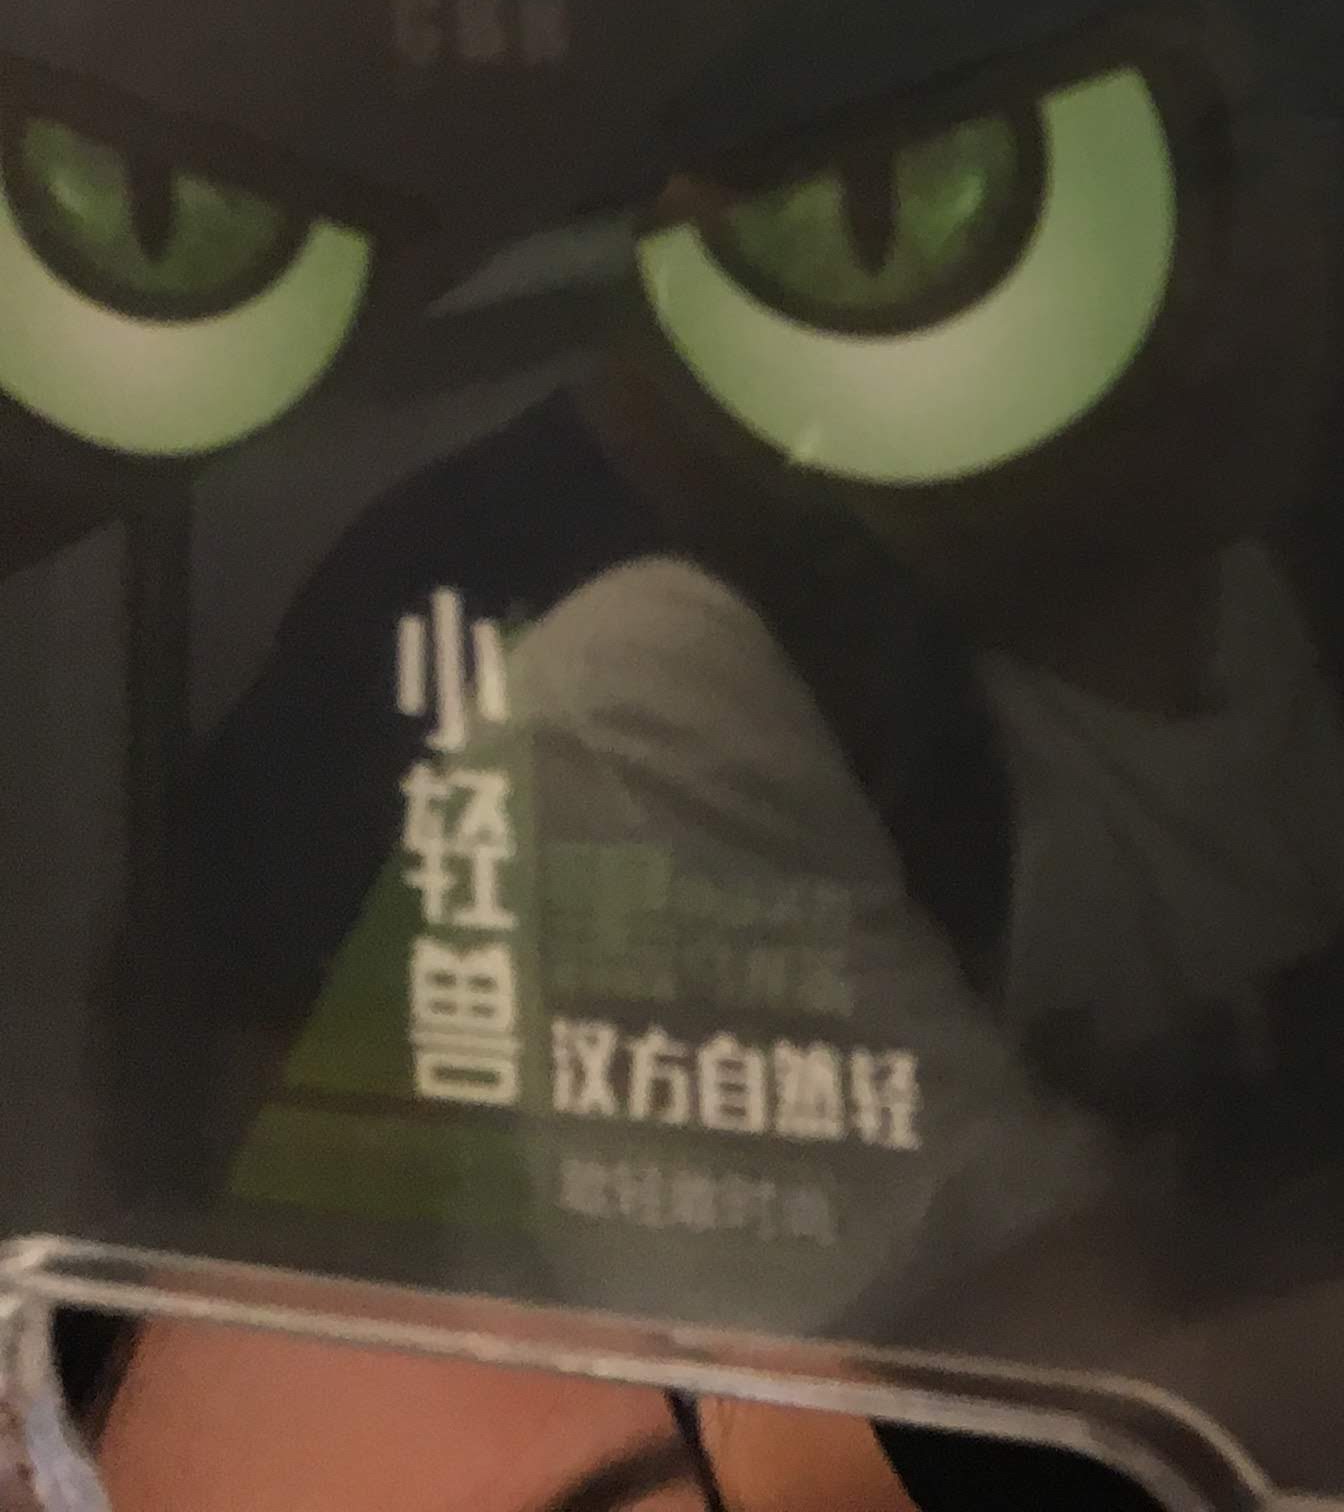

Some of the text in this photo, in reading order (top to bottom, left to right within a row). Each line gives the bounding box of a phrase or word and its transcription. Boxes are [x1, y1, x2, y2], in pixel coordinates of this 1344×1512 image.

[551, 1014, 922, 1151] 汉方自然轻
